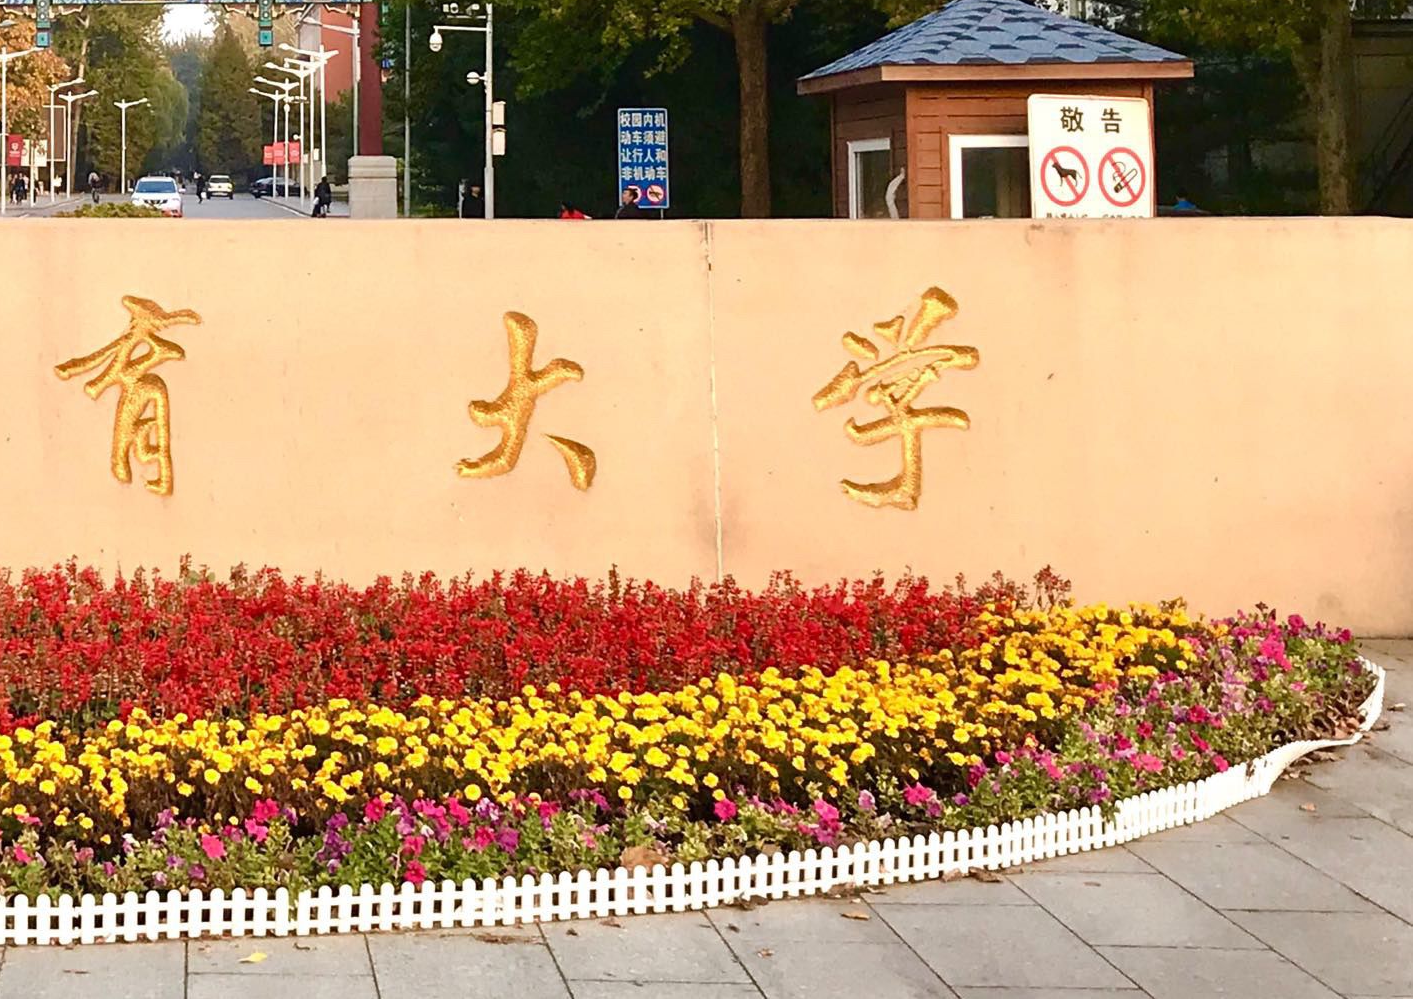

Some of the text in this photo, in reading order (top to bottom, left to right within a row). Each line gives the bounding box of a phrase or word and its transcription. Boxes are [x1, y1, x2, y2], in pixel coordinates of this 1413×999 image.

[620, 112, 666, 127] 校园内机
[1060, 106, 1123, 133] 敬告
[620, 130, 666, 145] 动车须避
[621, 148, 667, 163] 让行人和
[622, 166, 667, 181] 非机动车
